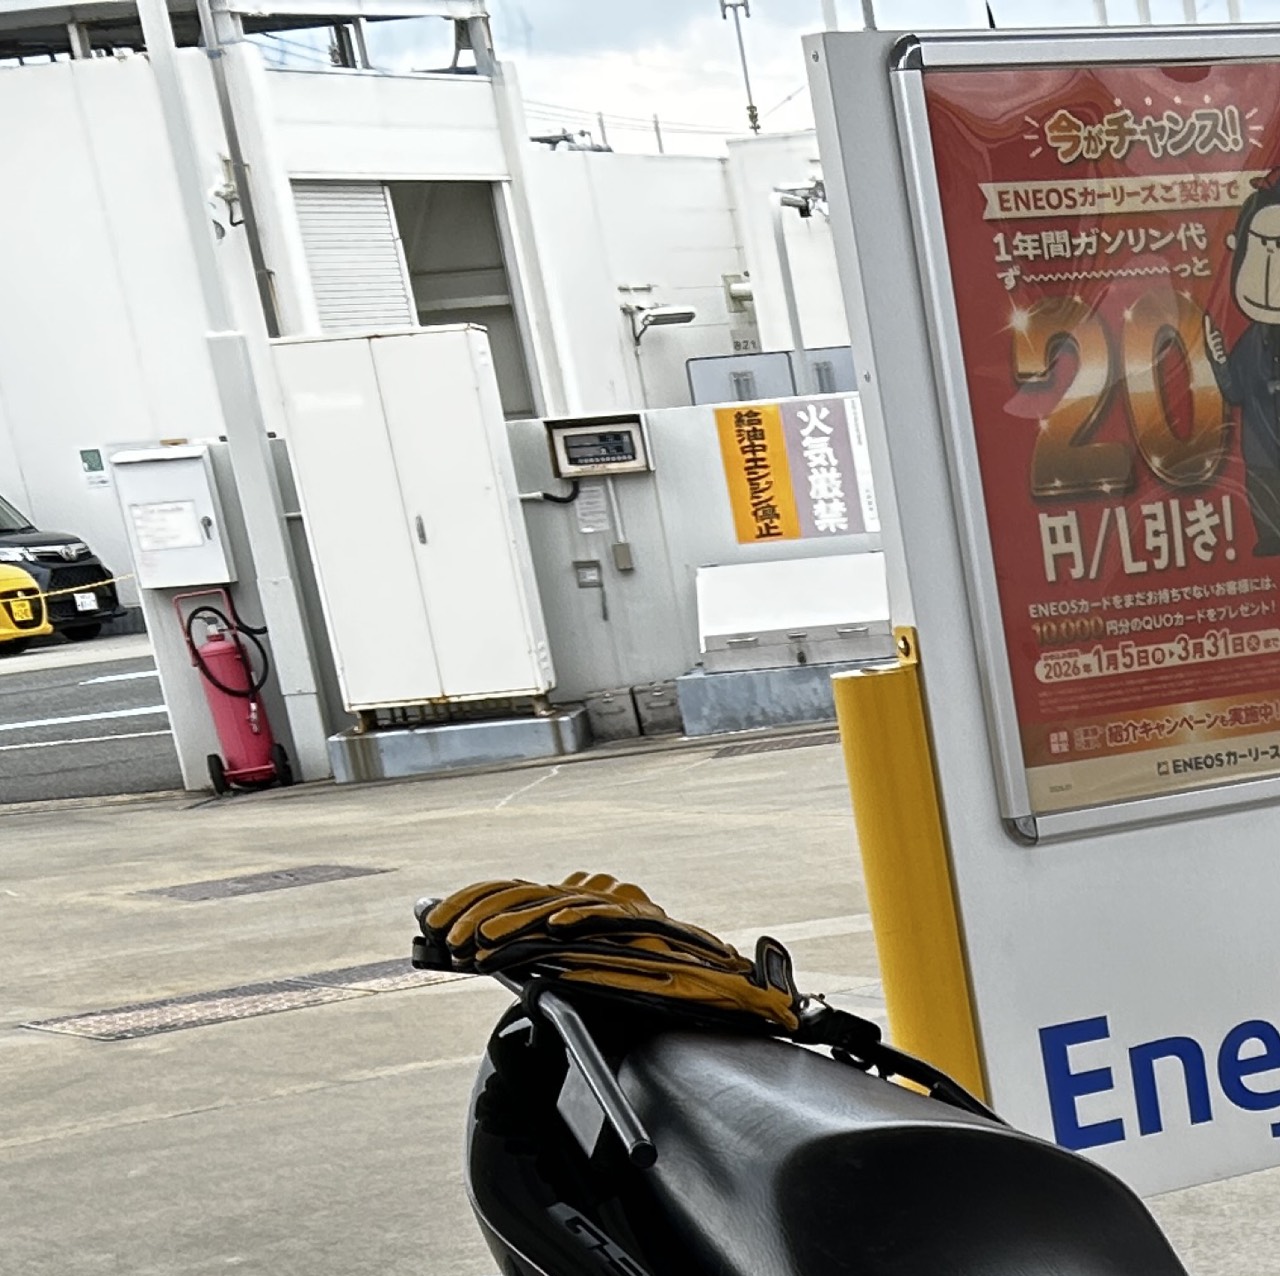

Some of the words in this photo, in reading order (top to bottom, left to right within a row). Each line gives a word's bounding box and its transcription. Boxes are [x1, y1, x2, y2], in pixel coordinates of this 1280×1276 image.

[1045, 104, 1243, 163] 今がチャンス!
[998, 178, 1241, 213] ENEOSカーリースご契約で
[992, 221, 1208, 263] 1年間ガソリン代
[1012, 295, 1228, 502] 20
[733, 409, 783, 539] 給油中エンジン停止
[796, 404, 848, 533] 火気厳禁
[1038, 495, 1237, 582] 円/L引き!
